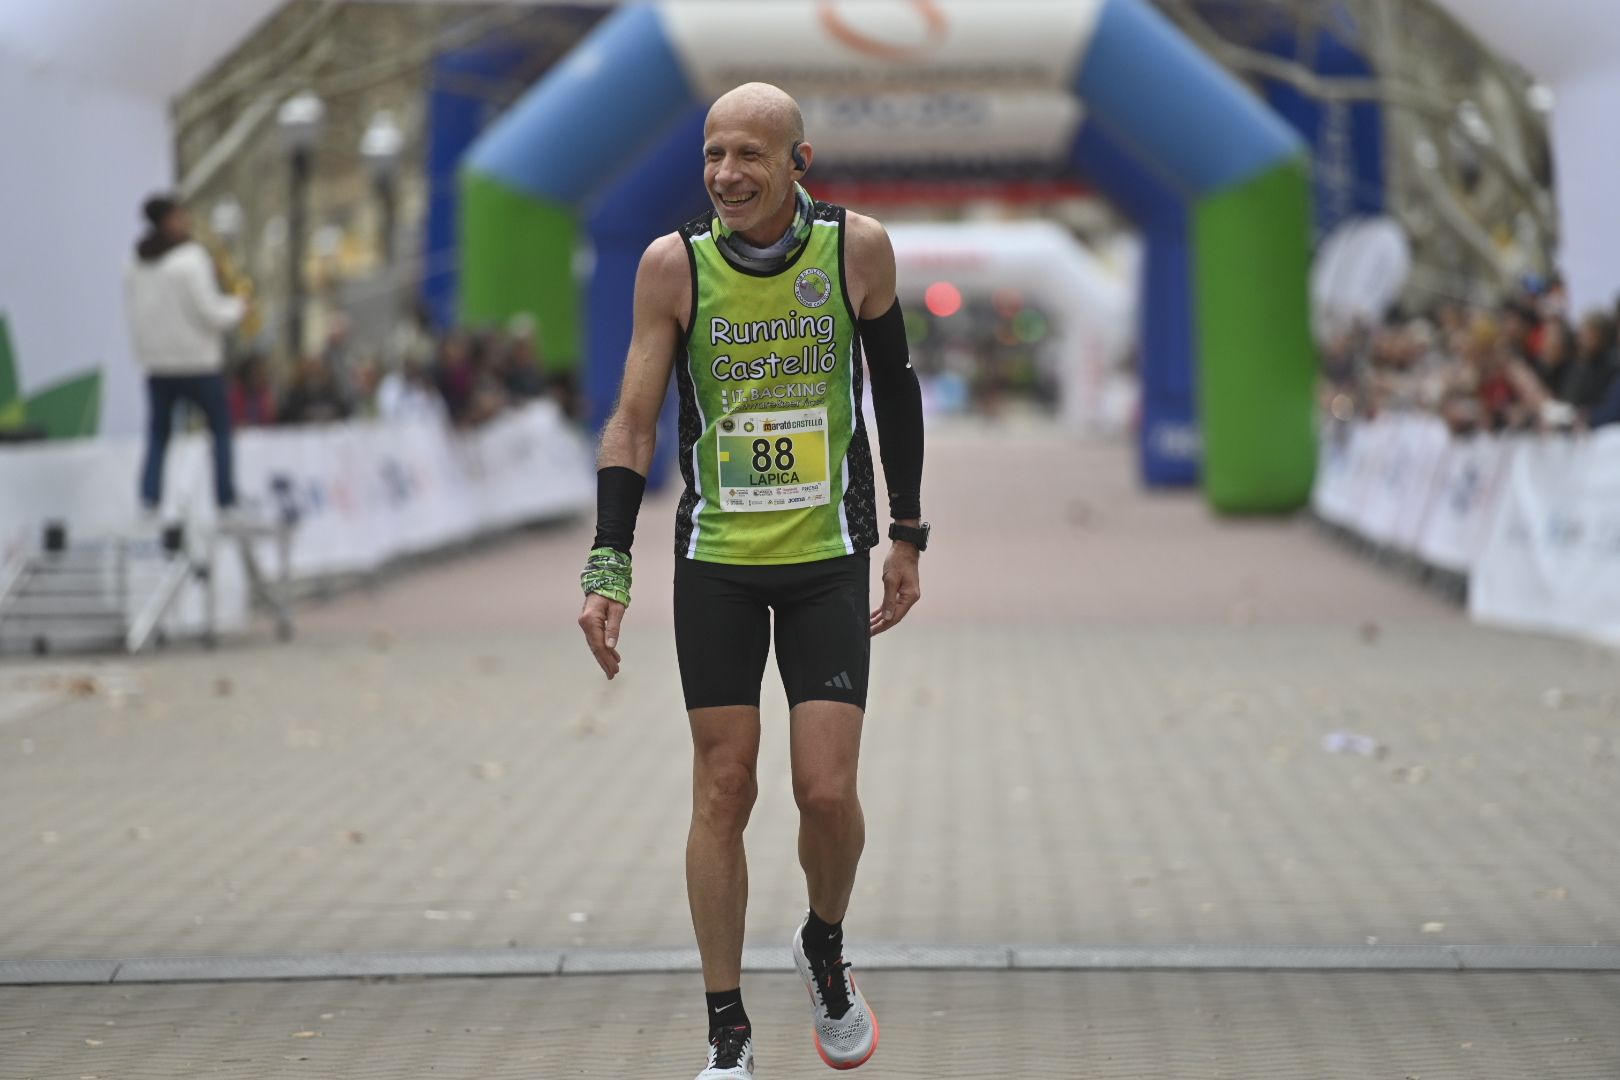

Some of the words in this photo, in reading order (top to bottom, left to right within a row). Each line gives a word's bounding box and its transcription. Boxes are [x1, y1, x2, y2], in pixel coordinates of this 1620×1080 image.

[710, 310, 835, 346] Running
[711, 342, 836, 381] Castelló
[750, 382, 827, 401] BACKING
[791, 417, 823, 429] CASTELLÓ
[752, 437, 795, 473] 88
[749, 472, 800, 486] LAPICA
